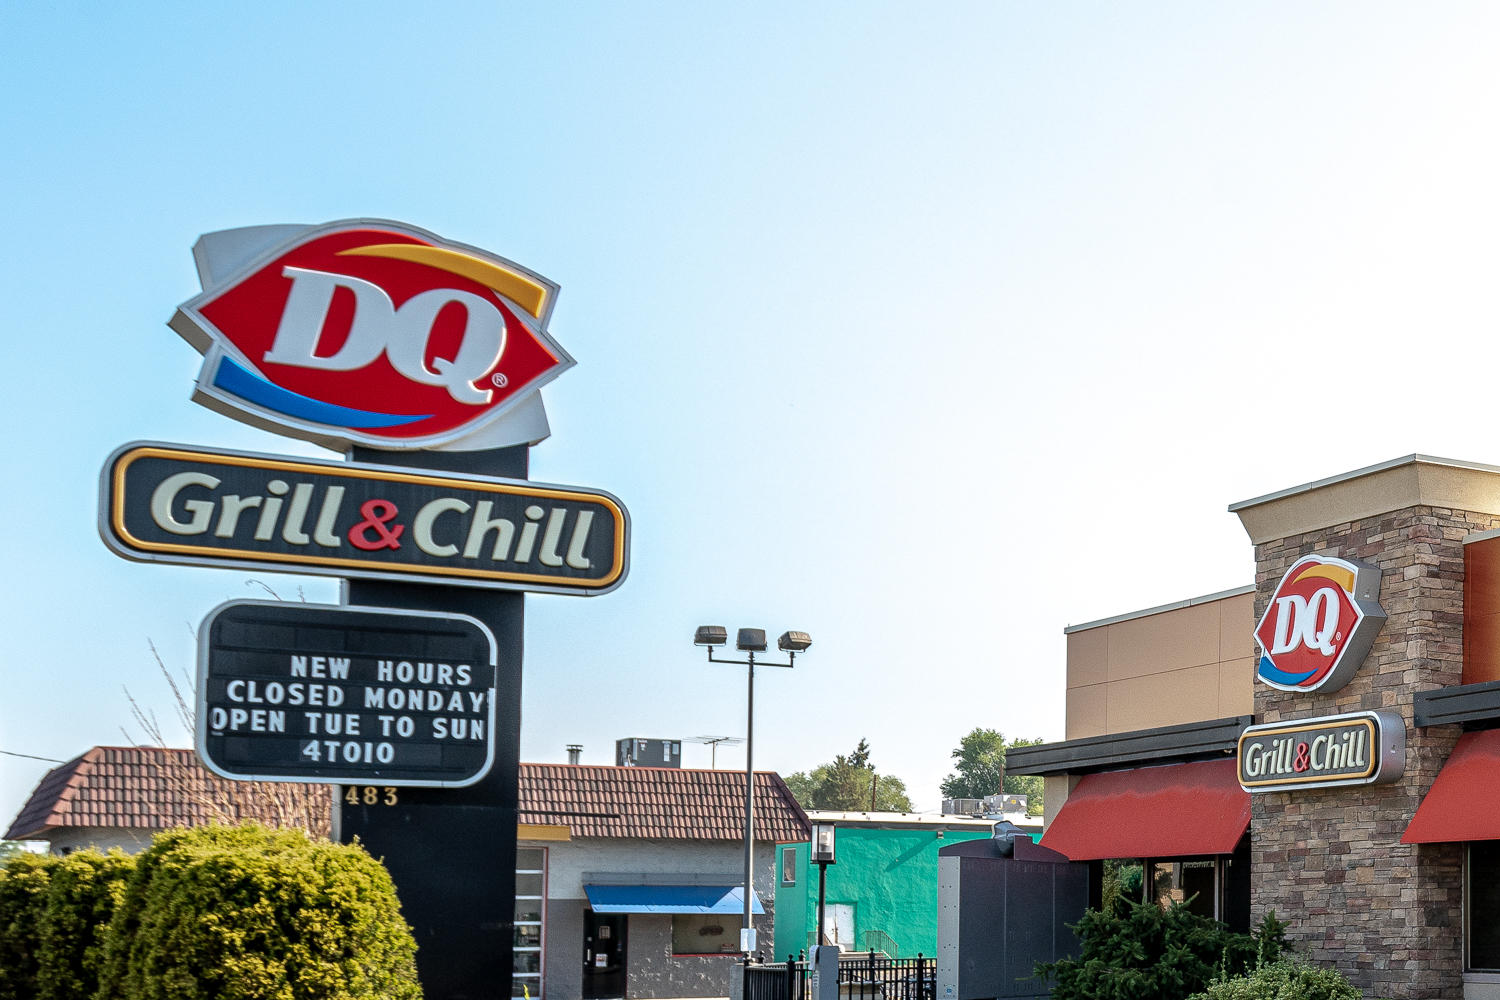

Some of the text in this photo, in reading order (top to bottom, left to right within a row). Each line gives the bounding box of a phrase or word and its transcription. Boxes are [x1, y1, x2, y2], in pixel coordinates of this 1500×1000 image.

[263, 265, 507, 405] DQ
[151, 471, 594, 569] Grill & Chill
[1271, 587, 1340, 657] DQ
[290, 655, 472, 686] NEW HOURS
[227, 680, 487, 713] CLOSED MONDAY
[209, 707, 485, 740] OPEN TUE TO SUN
[1245, 729, 1366, 777] Grill & Chill
[345, 786, 398, 806] 483
